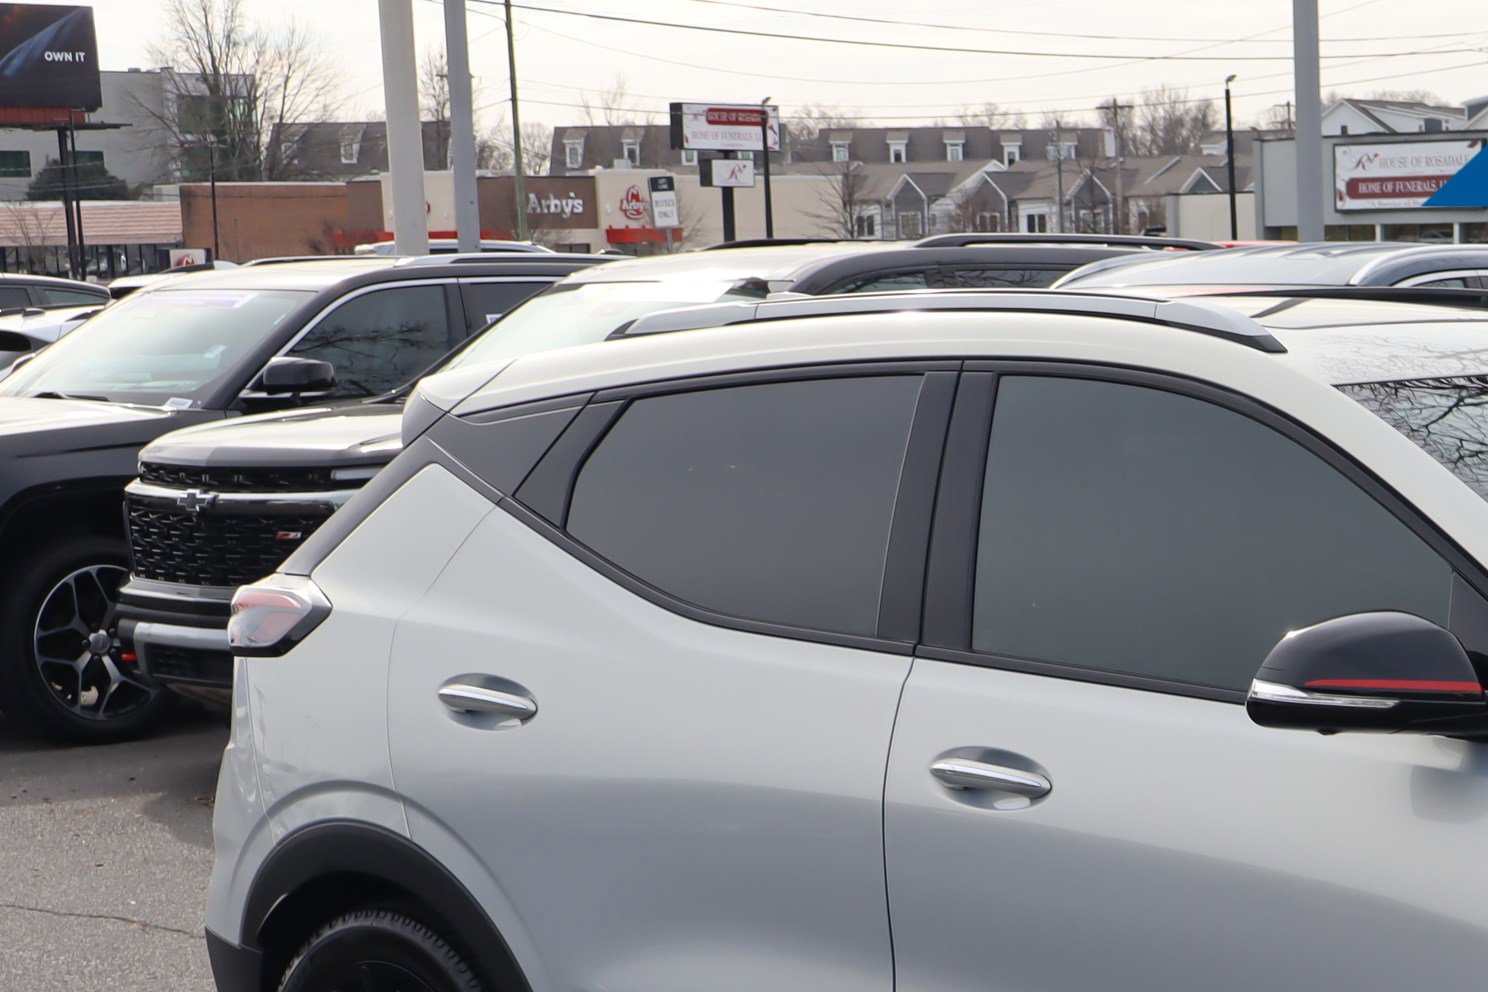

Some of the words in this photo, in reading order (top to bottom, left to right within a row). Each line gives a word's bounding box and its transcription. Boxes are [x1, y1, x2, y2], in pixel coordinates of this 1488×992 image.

[44, 51, 73, 62] OWN
[75, 51, 86, 62] IT
[1379, 157, 1407, 169] HOUSE
[1411, 156, 1423, 168] OF
[1358, 182, 1381, 194] HOME
[1382, 182, 1395, 193] OF
[527, 192, 584, 219] Arby's
[658, 210, 675, 219] ONLY
